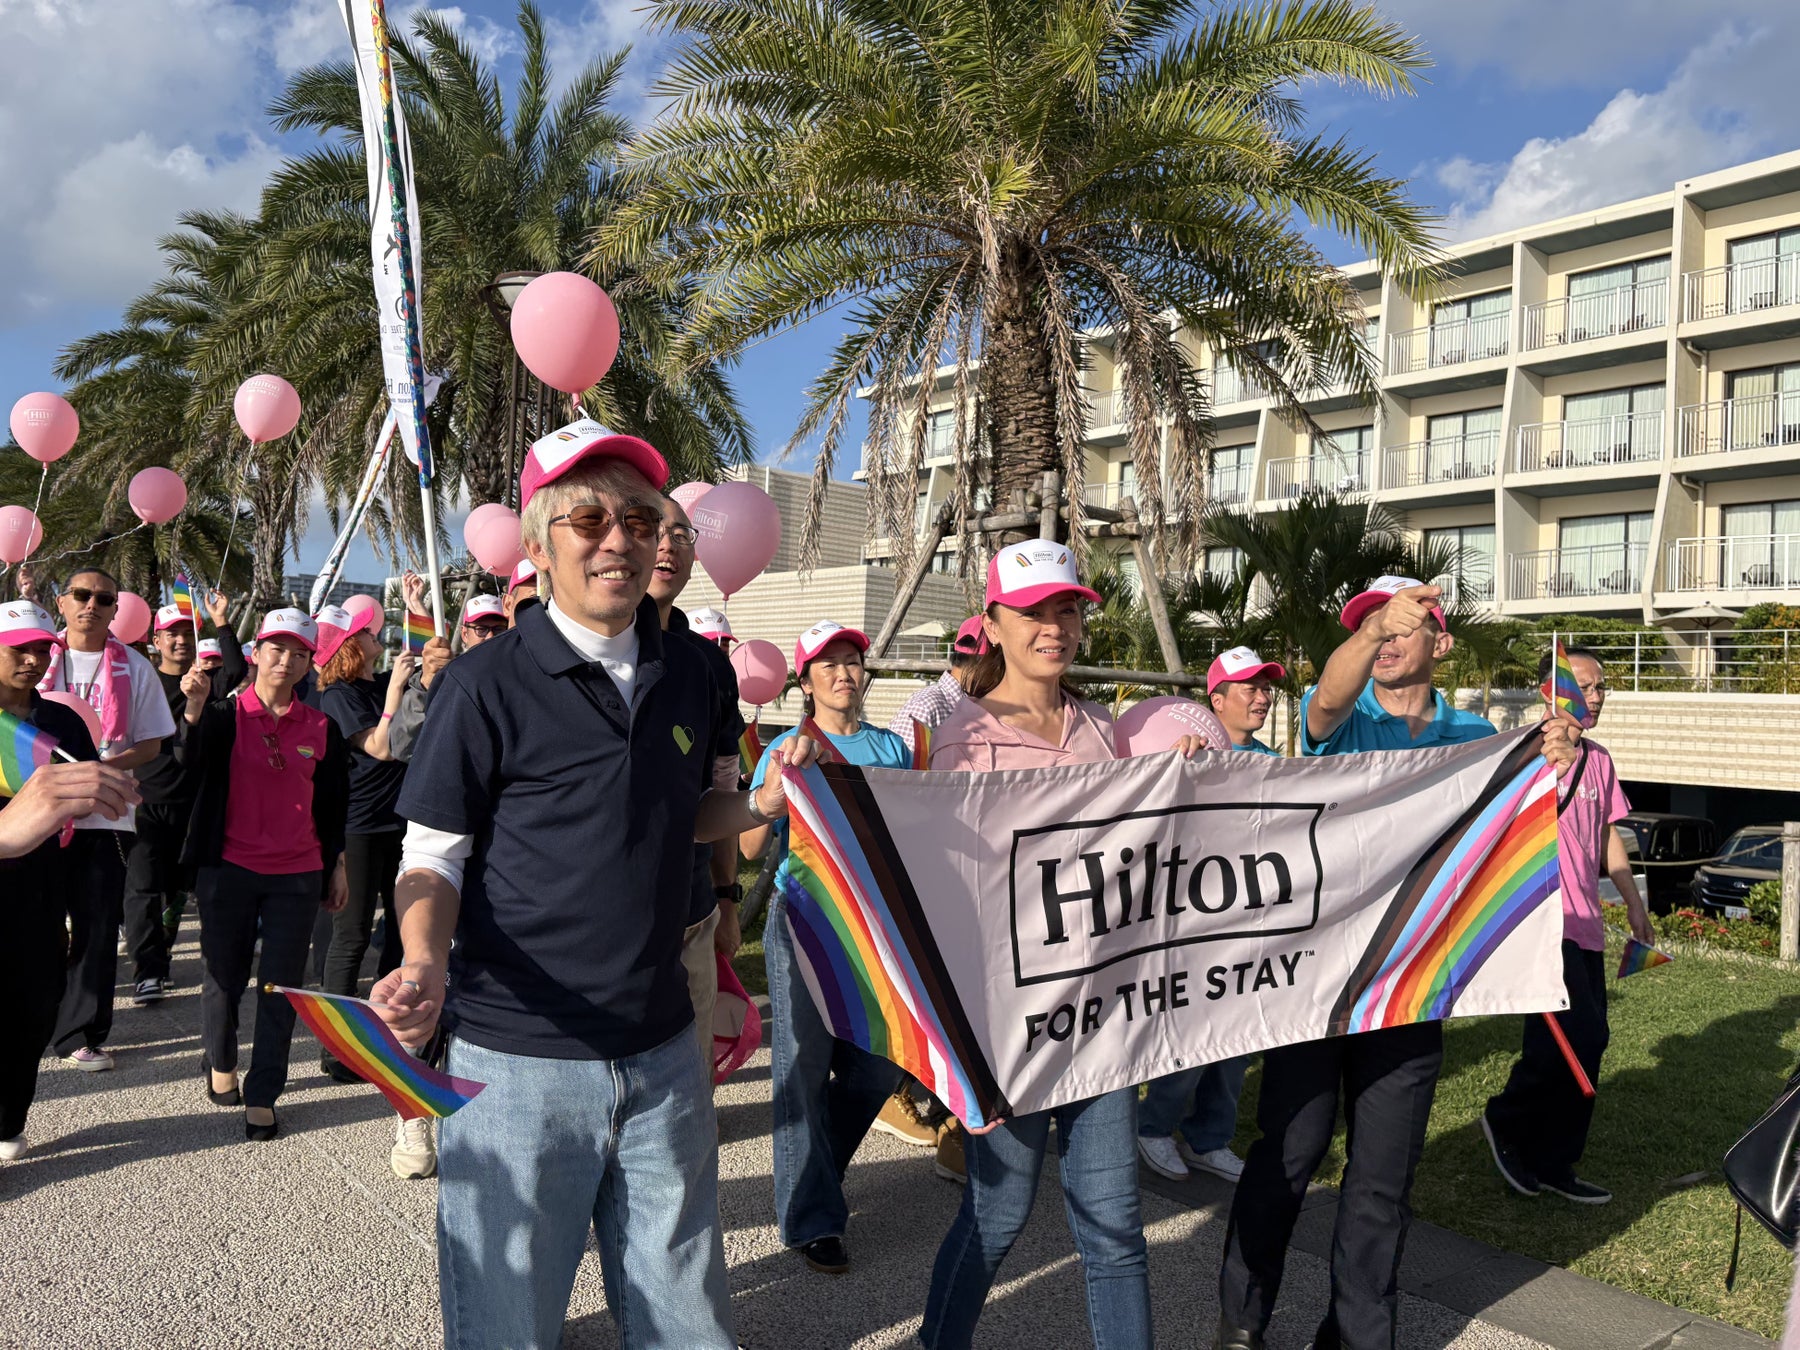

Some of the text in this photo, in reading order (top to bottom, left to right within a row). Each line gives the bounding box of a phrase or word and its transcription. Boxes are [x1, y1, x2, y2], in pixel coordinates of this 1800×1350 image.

[1168, 712, 1188, 724] FOR
[1190, 721, 1206, 738] THE
[1037, 842, 1293, 946] Hilton
[1025, 997, 1103, 1053] FOR
[1116, 971, 1189, 1022] THE
